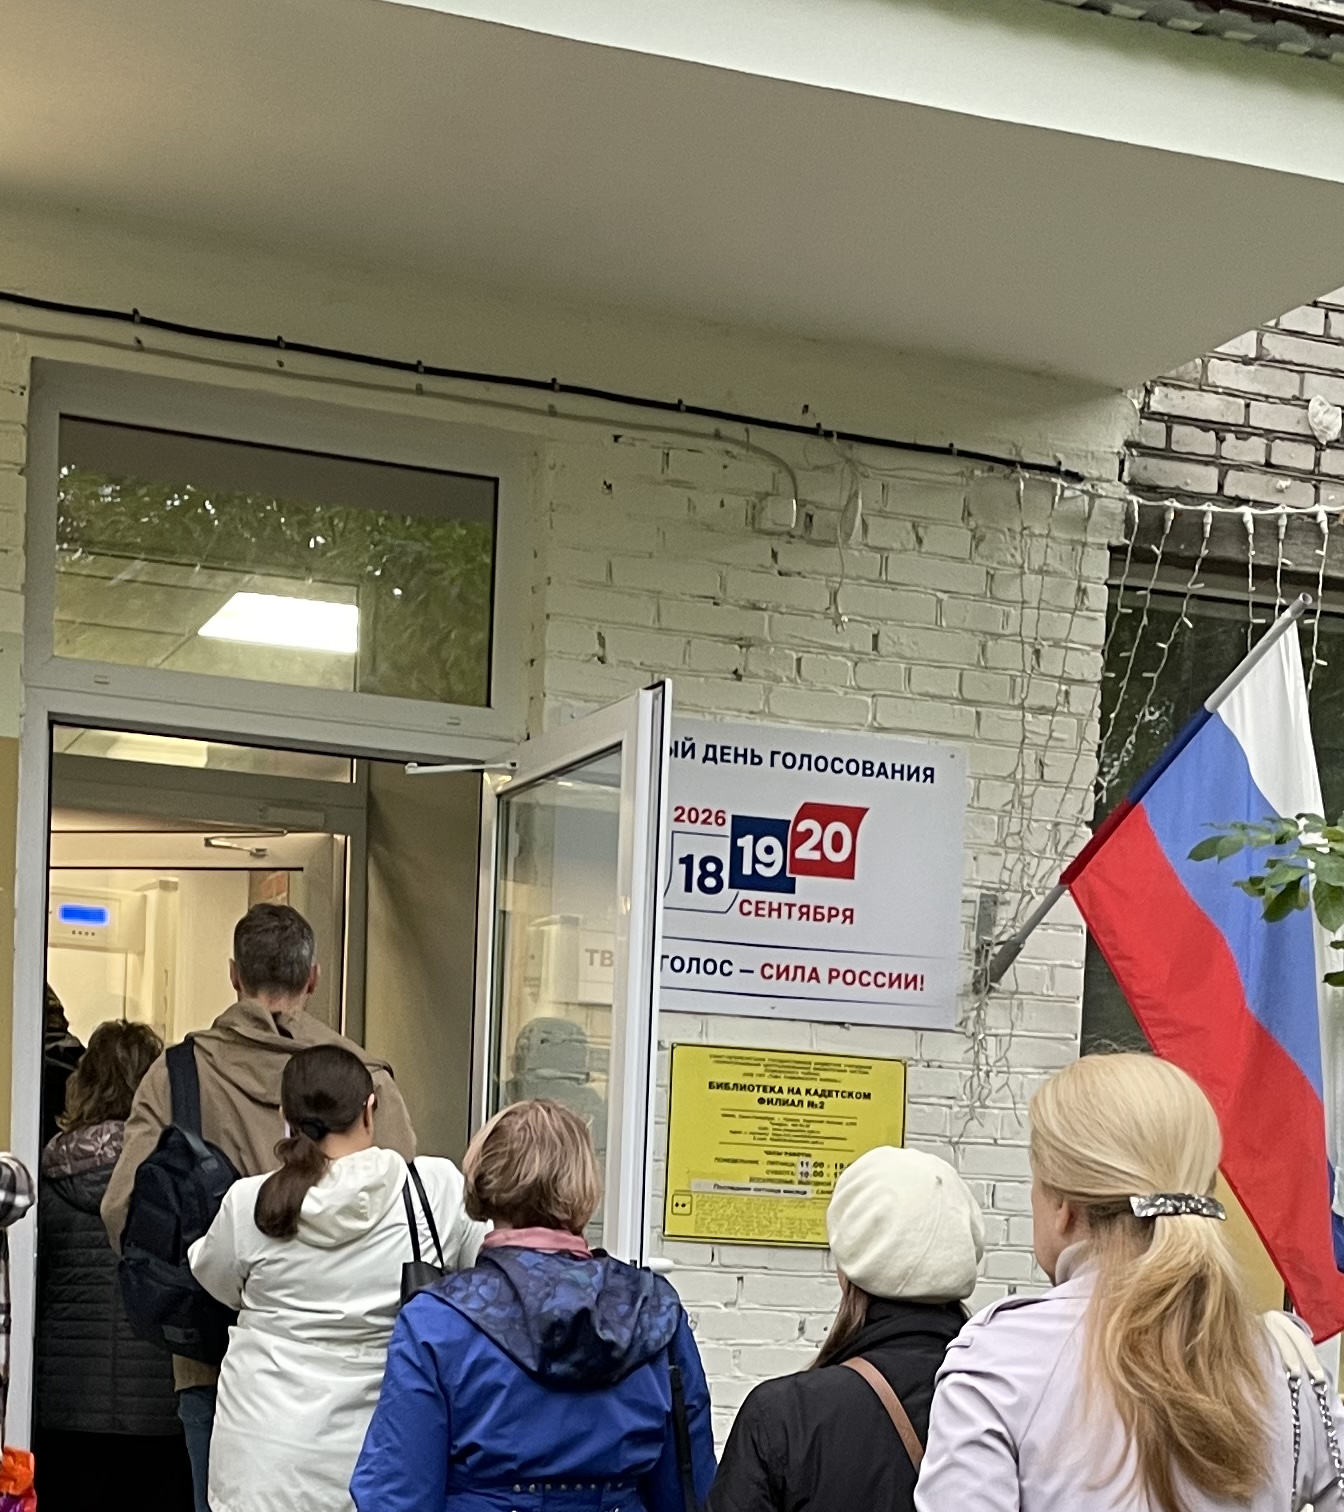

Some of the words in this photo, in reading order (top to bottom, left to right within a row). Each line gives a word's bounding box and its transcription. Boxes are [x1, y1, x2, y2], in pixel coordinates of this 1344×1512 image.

[702, 744, 763, 766] ДЕНЬ
[769, 750, 936, 784] ГОЛОСОВАНИЯ
[672, 805, 727, 827] 2026
[678, 853, 724, 895] 18
[736, 834, 783, 878] 19
[794, 818, 853, 863] 20
[738, 899, 855, 925] СЕНТЯБРЯ
[584, 948, 615, 967] ТВ
[659, 954, 734, 977] ГОЛОС
[759, 963, 821, 985] СИЛА
[827, 968, 925, 992] РОССИИ!
[708, 1081, 784, 1096] БИБЛИОТЕКА
[787, 1086, 802, 1097] НА
[805, 1088, 872, 1101] КАДЕТСКОМ
[757, 1097, 804, 1109] ФИЛИАЛ
